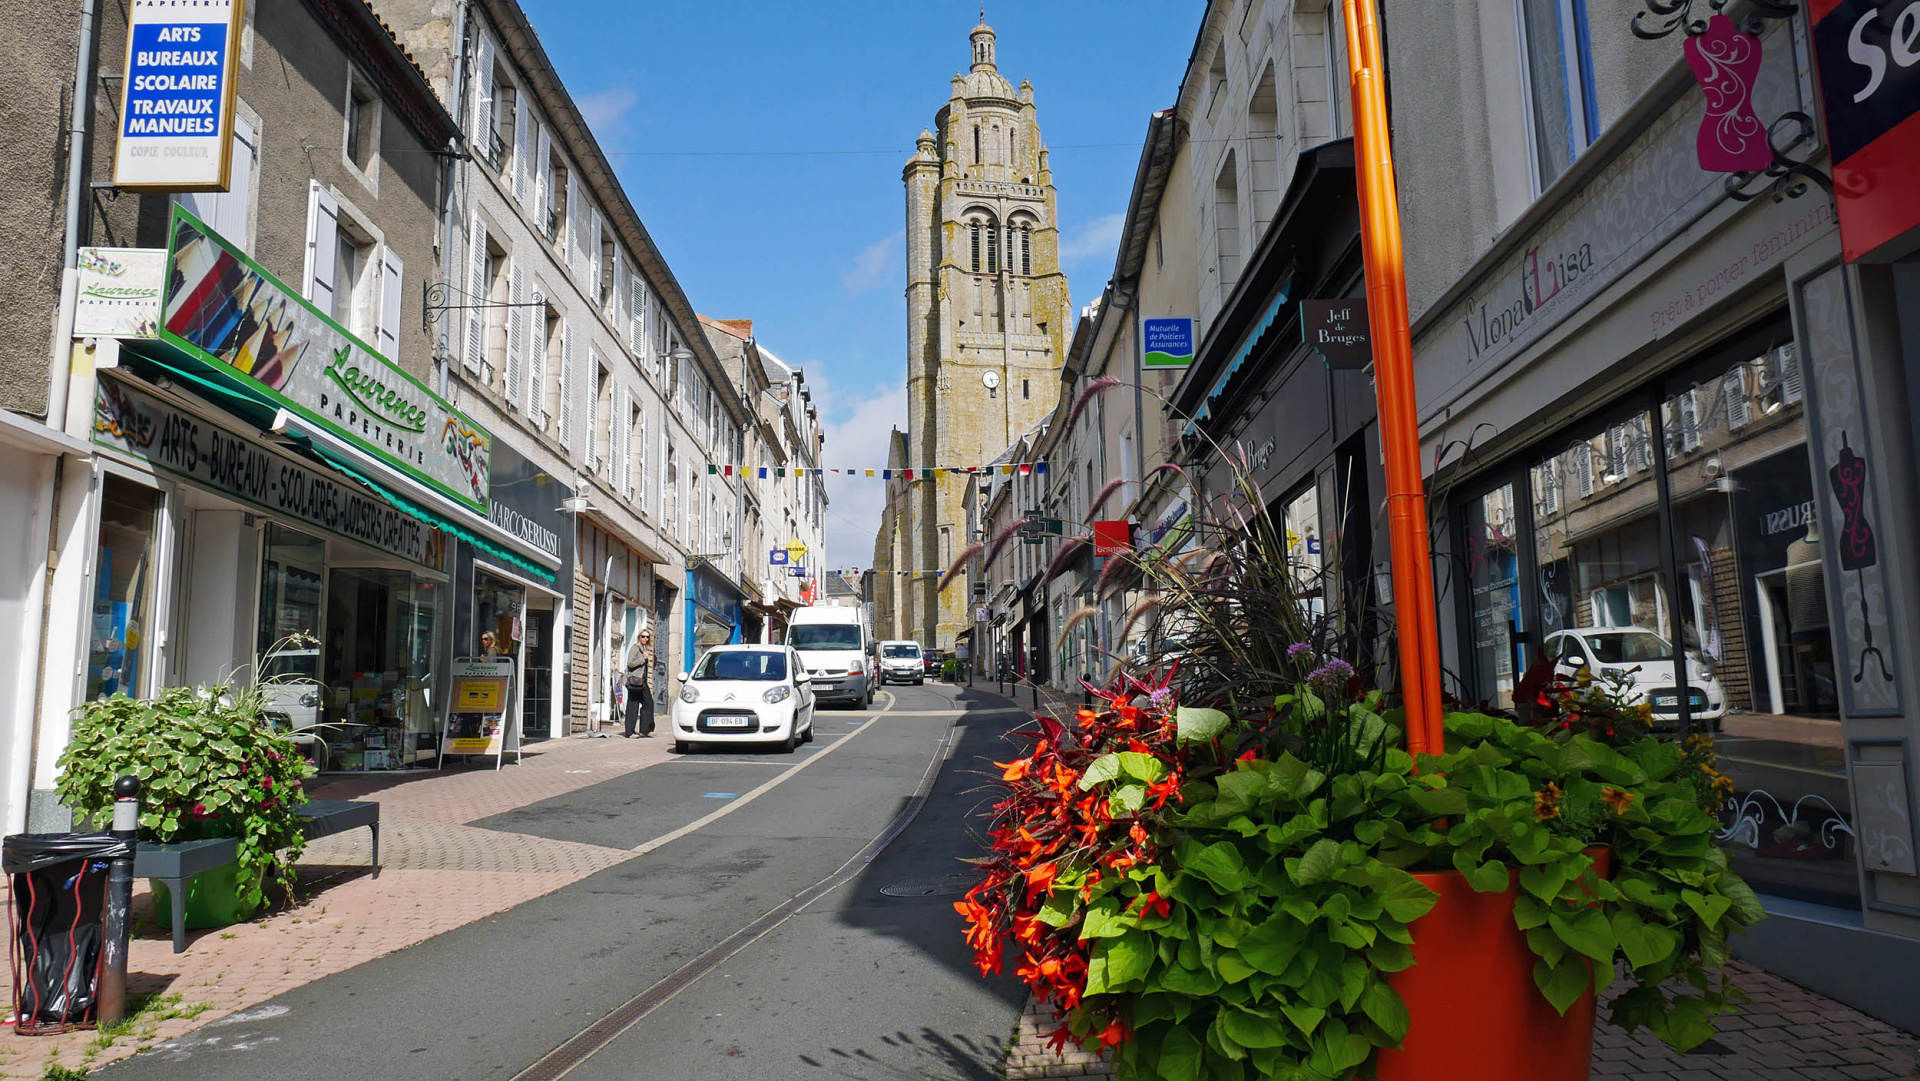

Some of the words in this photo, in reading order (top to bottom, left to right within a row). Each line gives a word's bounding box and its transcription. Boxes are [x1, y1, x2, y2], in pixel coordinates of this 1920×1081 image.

[157, 27, 201, 42] ARTS
[137, 51, 218, 66] BUREAUX
[134, 75, 217, 91] SCOLAIRE
[133, 99, 213, 114] TRAVAUX
[128, 117, 214, 134] MANUELS
[130, 146, 159, 158] COPIE
[163, 146, 209, 159] COULEUR
[1651, 300, 1683, 332] Prêt
[1685, 291, 1695, 311] à
[1696, 256, 1749, 308] porter
[1752, 203, 1832, 267] féminin
[81, 282, 158, 299] Laurence
[1463, 297, 1526, 365] Mona
[1533, 243, 1594, 311] Lisa
[1326, 308, 1351, 323] Jeff
[1334, 323, 1346, 331] de
[1318, 328, 1366, 346] Bruges
[323, 343, 427, 434] Laurence
[320, 393, 424, 465] PAPETERIE
[1247, 436, 1275, 474] Bruges
[160, 413, 198, 472] ARTS
[210, 431, 269, 501] BUREAUX
[278, 464, 338, 527] SCOLAIRES
[343, 491, 382, 545] LOISIRS
